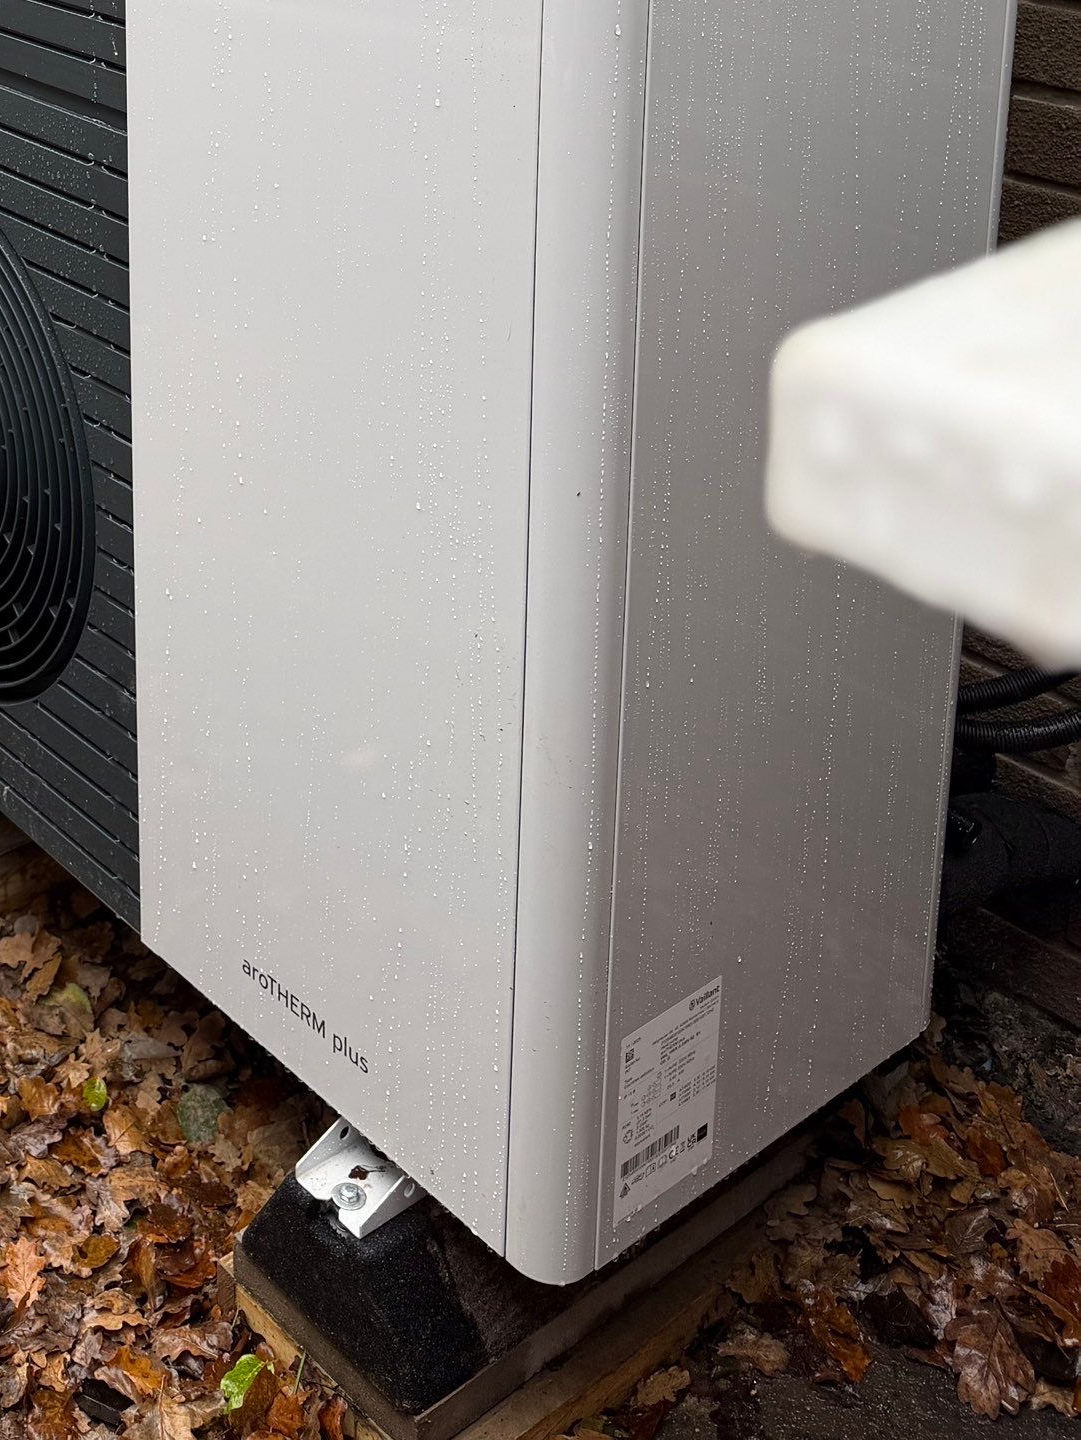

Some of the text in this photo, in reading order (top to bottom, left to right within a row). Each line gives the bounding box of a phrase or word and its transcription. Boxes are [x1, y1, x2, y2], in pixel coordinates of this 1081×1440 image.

[242, 959, 369, 1074] aroTHERM plus
[696, 985, 720, 1006] Vaillant
